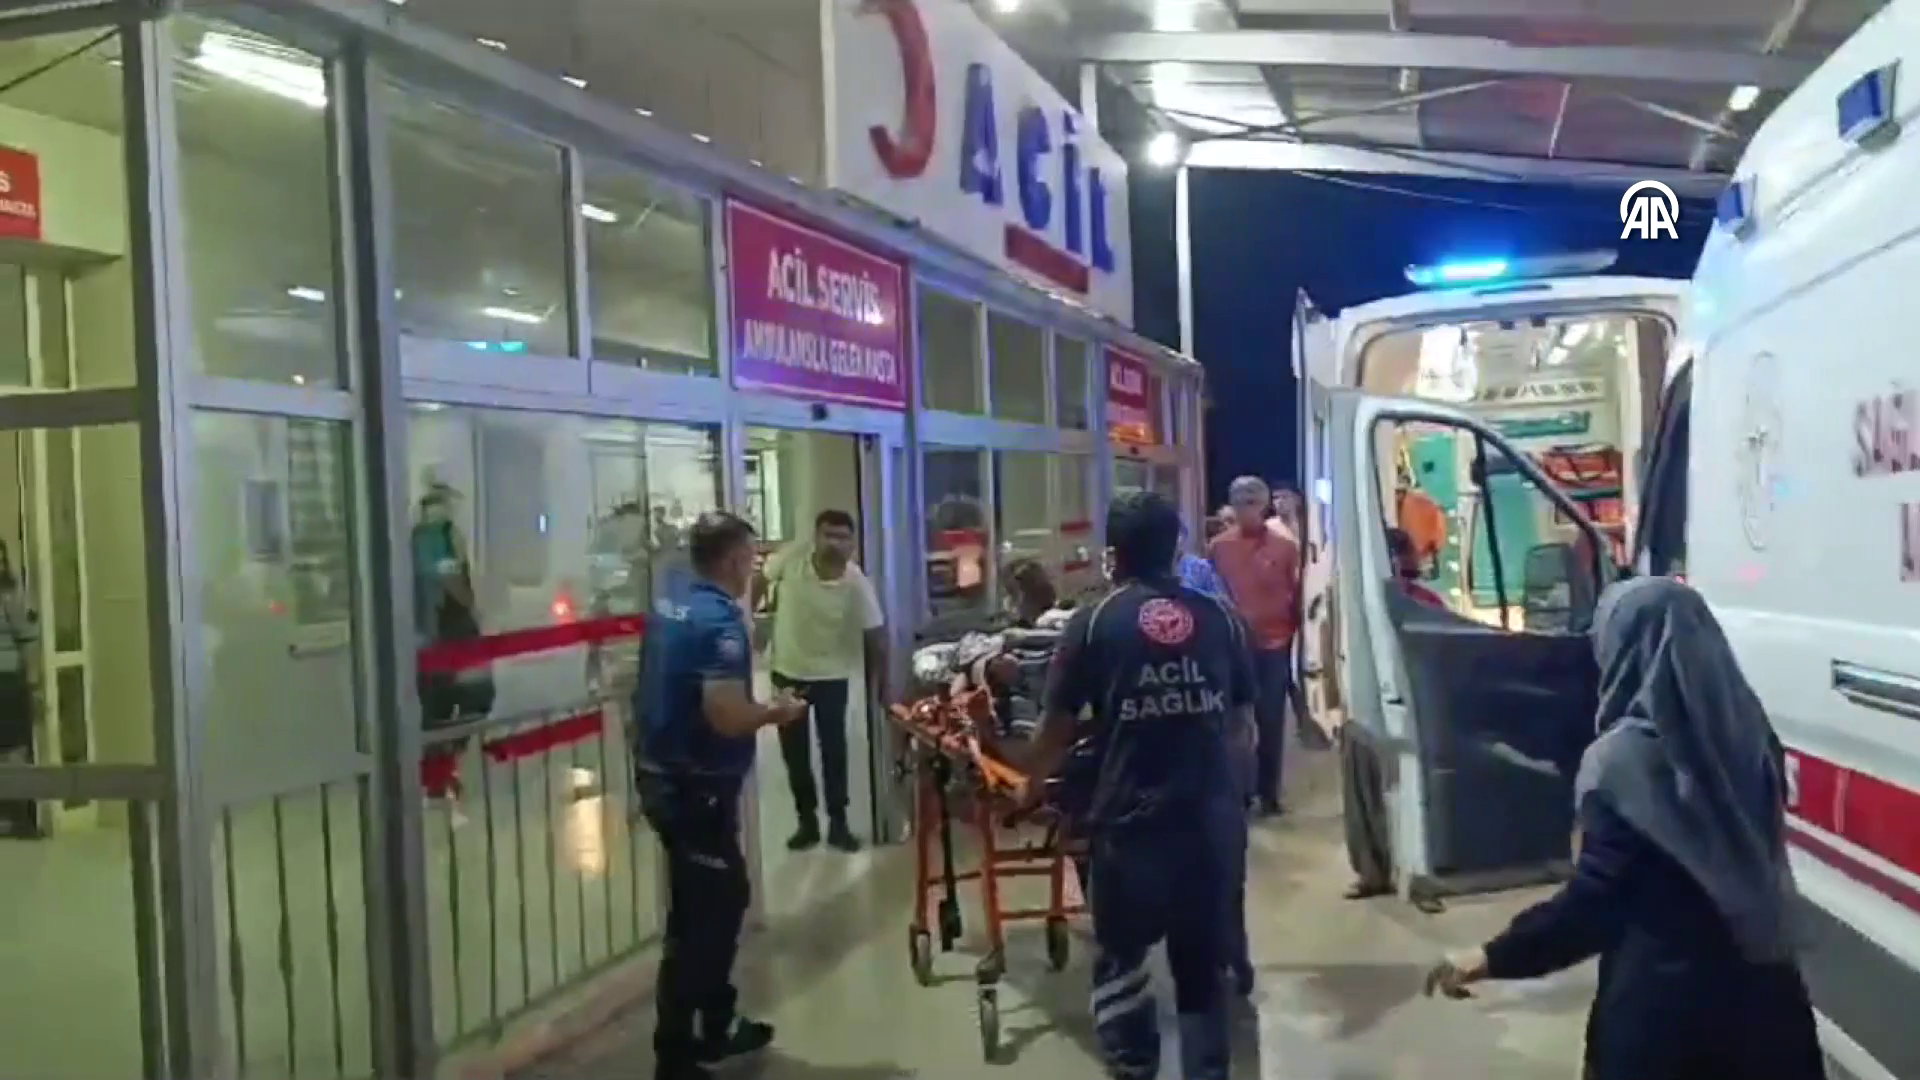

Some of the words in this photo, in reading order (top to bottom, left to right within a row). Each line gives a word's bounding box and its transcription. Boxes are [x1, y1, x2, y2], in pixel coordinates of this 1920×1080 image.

[767, 247, 815, 305] ACİL
[817, 265, 885, 326] SERVİS
[1119, 688, 1225, 720] SAĞLIK
